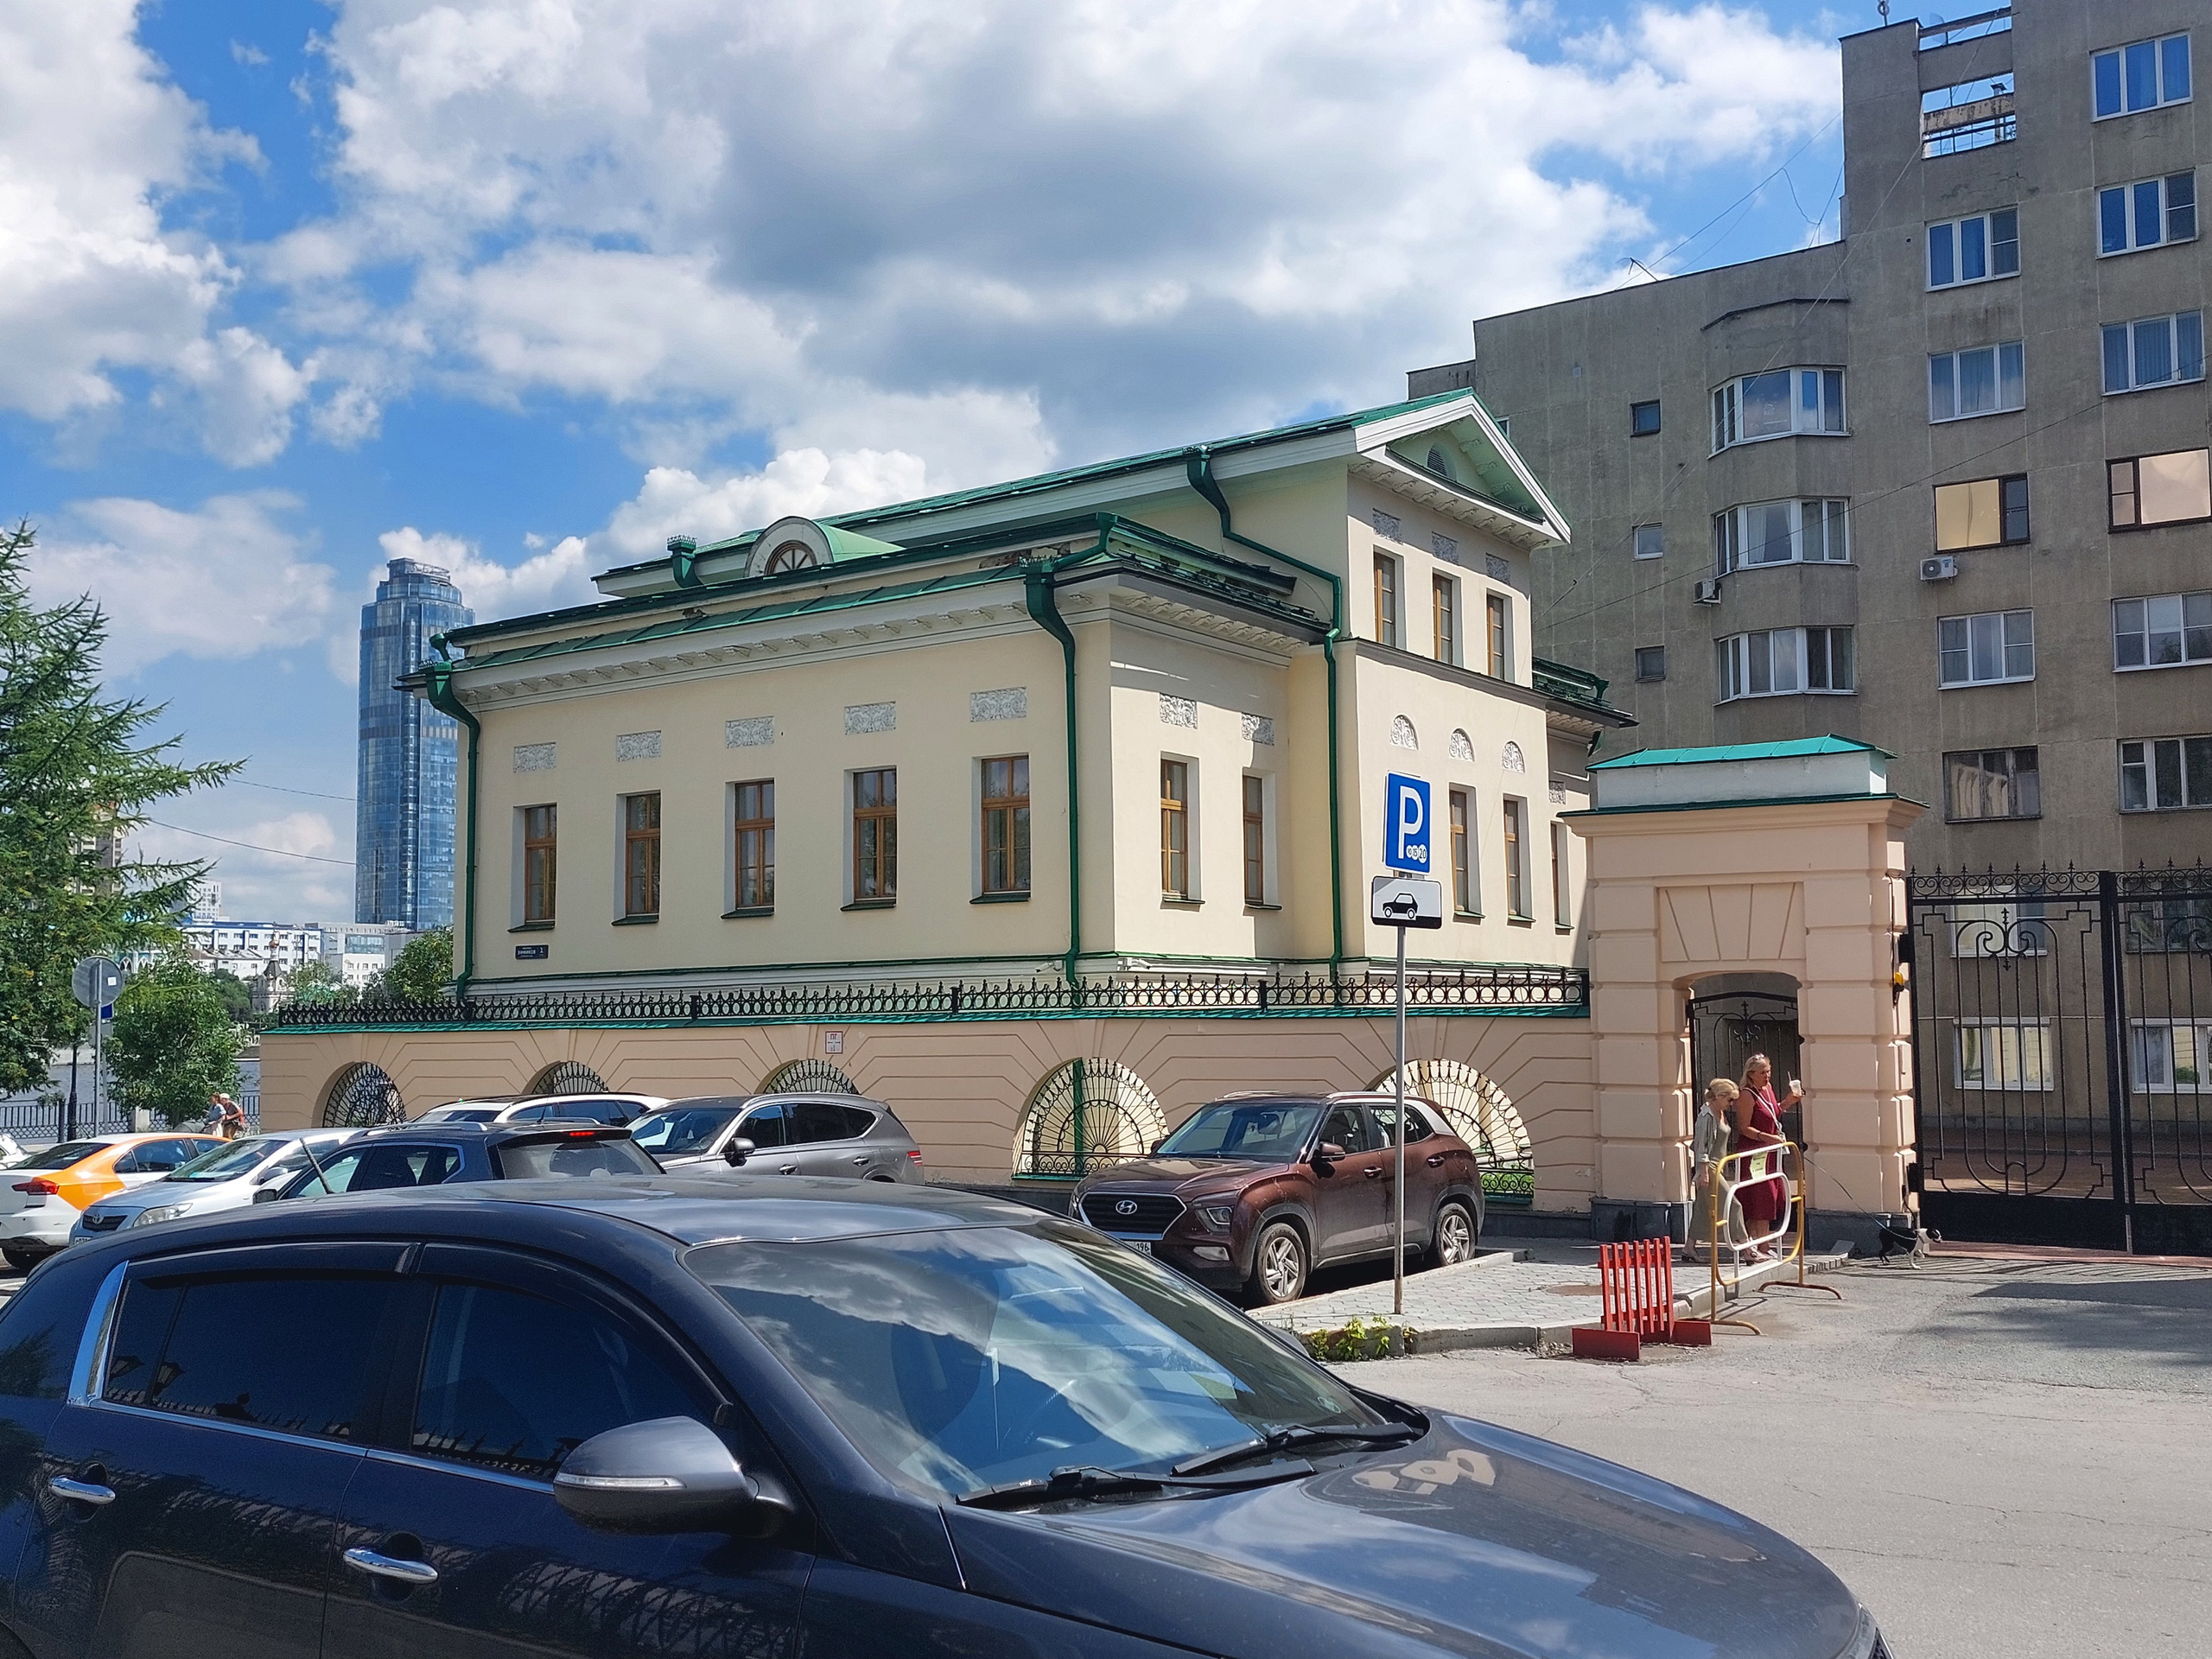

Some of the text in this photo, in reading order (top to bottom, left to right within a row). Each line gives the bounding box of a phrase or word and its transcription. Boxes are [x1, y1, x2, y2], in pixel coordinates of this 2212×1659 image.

[1398, 785, 1424, 860] P
[1419, 847, 1427, 860] 20
[1136, 1243, 1150, 1252] 196
